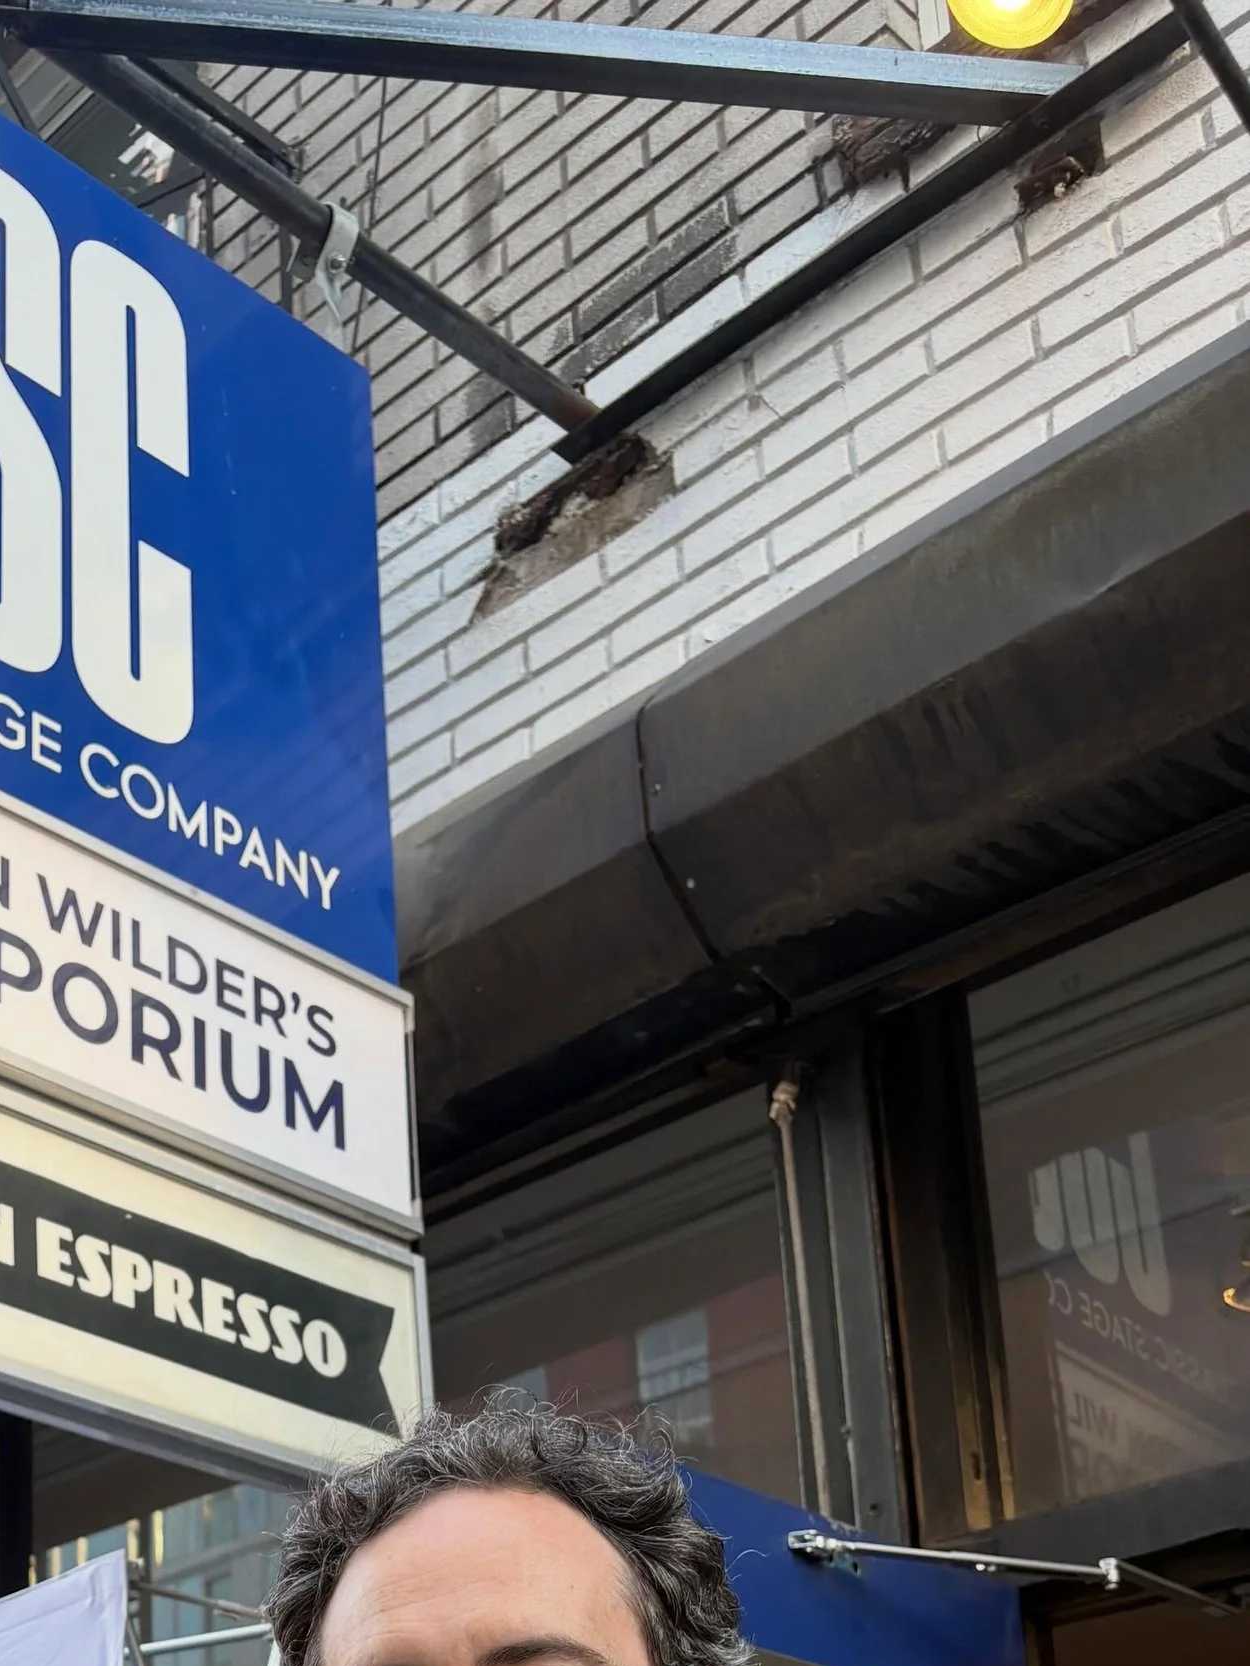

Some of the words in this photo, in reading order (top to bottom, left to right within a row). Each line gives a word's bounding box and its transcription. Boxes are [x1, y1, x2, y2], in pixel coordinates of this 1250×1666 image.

[80, 743, 340, 912] COMPANY
[37, 872, 337, 1058] WILDER'S
[36, 1214, 349, 1380] ESPRESSO
